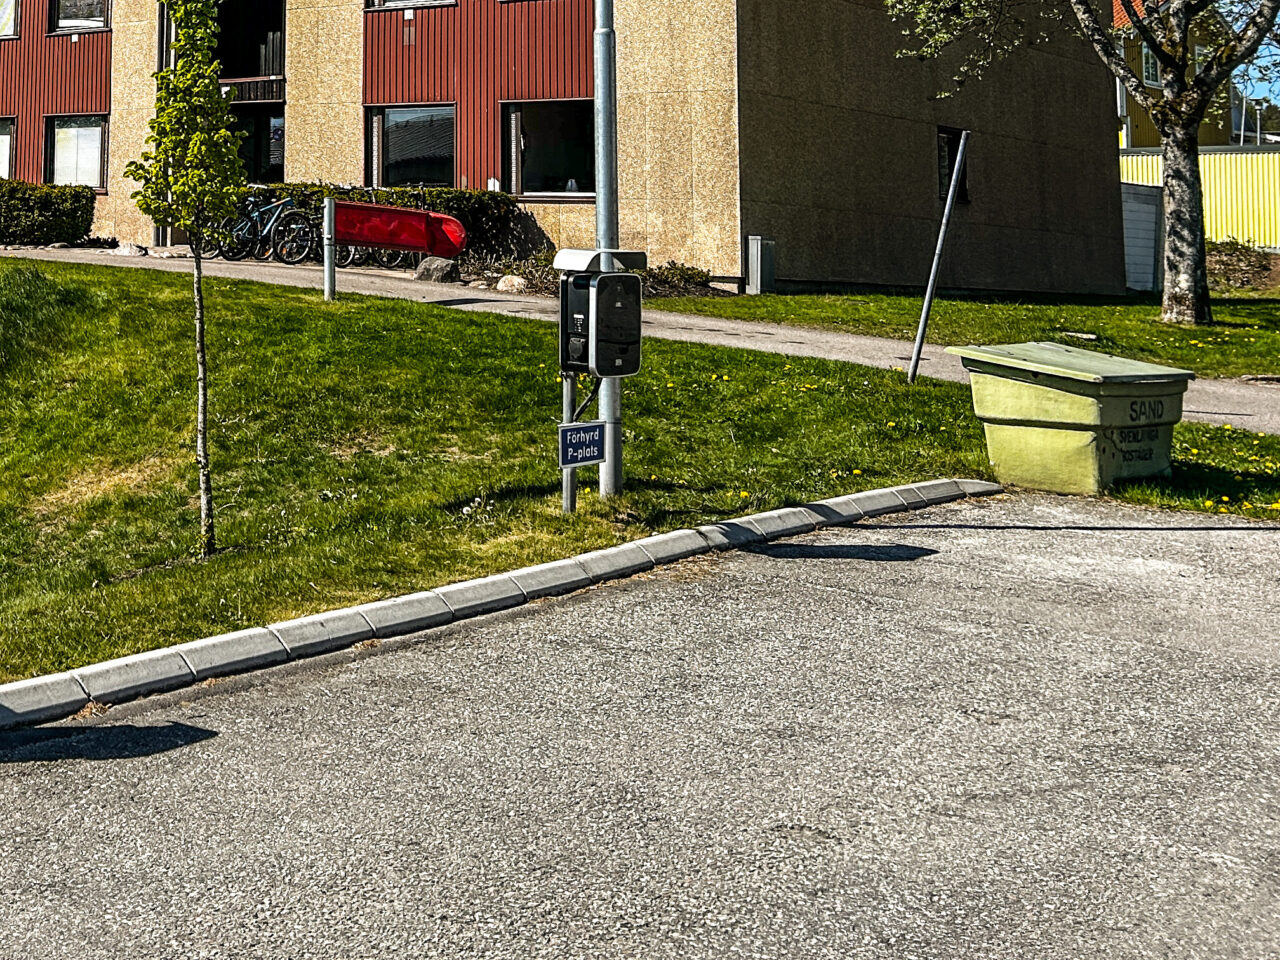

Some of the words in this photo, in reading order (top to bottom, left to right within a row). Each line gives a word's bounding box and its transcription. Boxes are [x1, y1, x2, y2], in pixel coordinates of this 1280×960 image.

[1129, 400, 1164, 422] SAND
[567, 428, 599, 444] Förhyrd
[568, 445, 598, 460] P-plats
